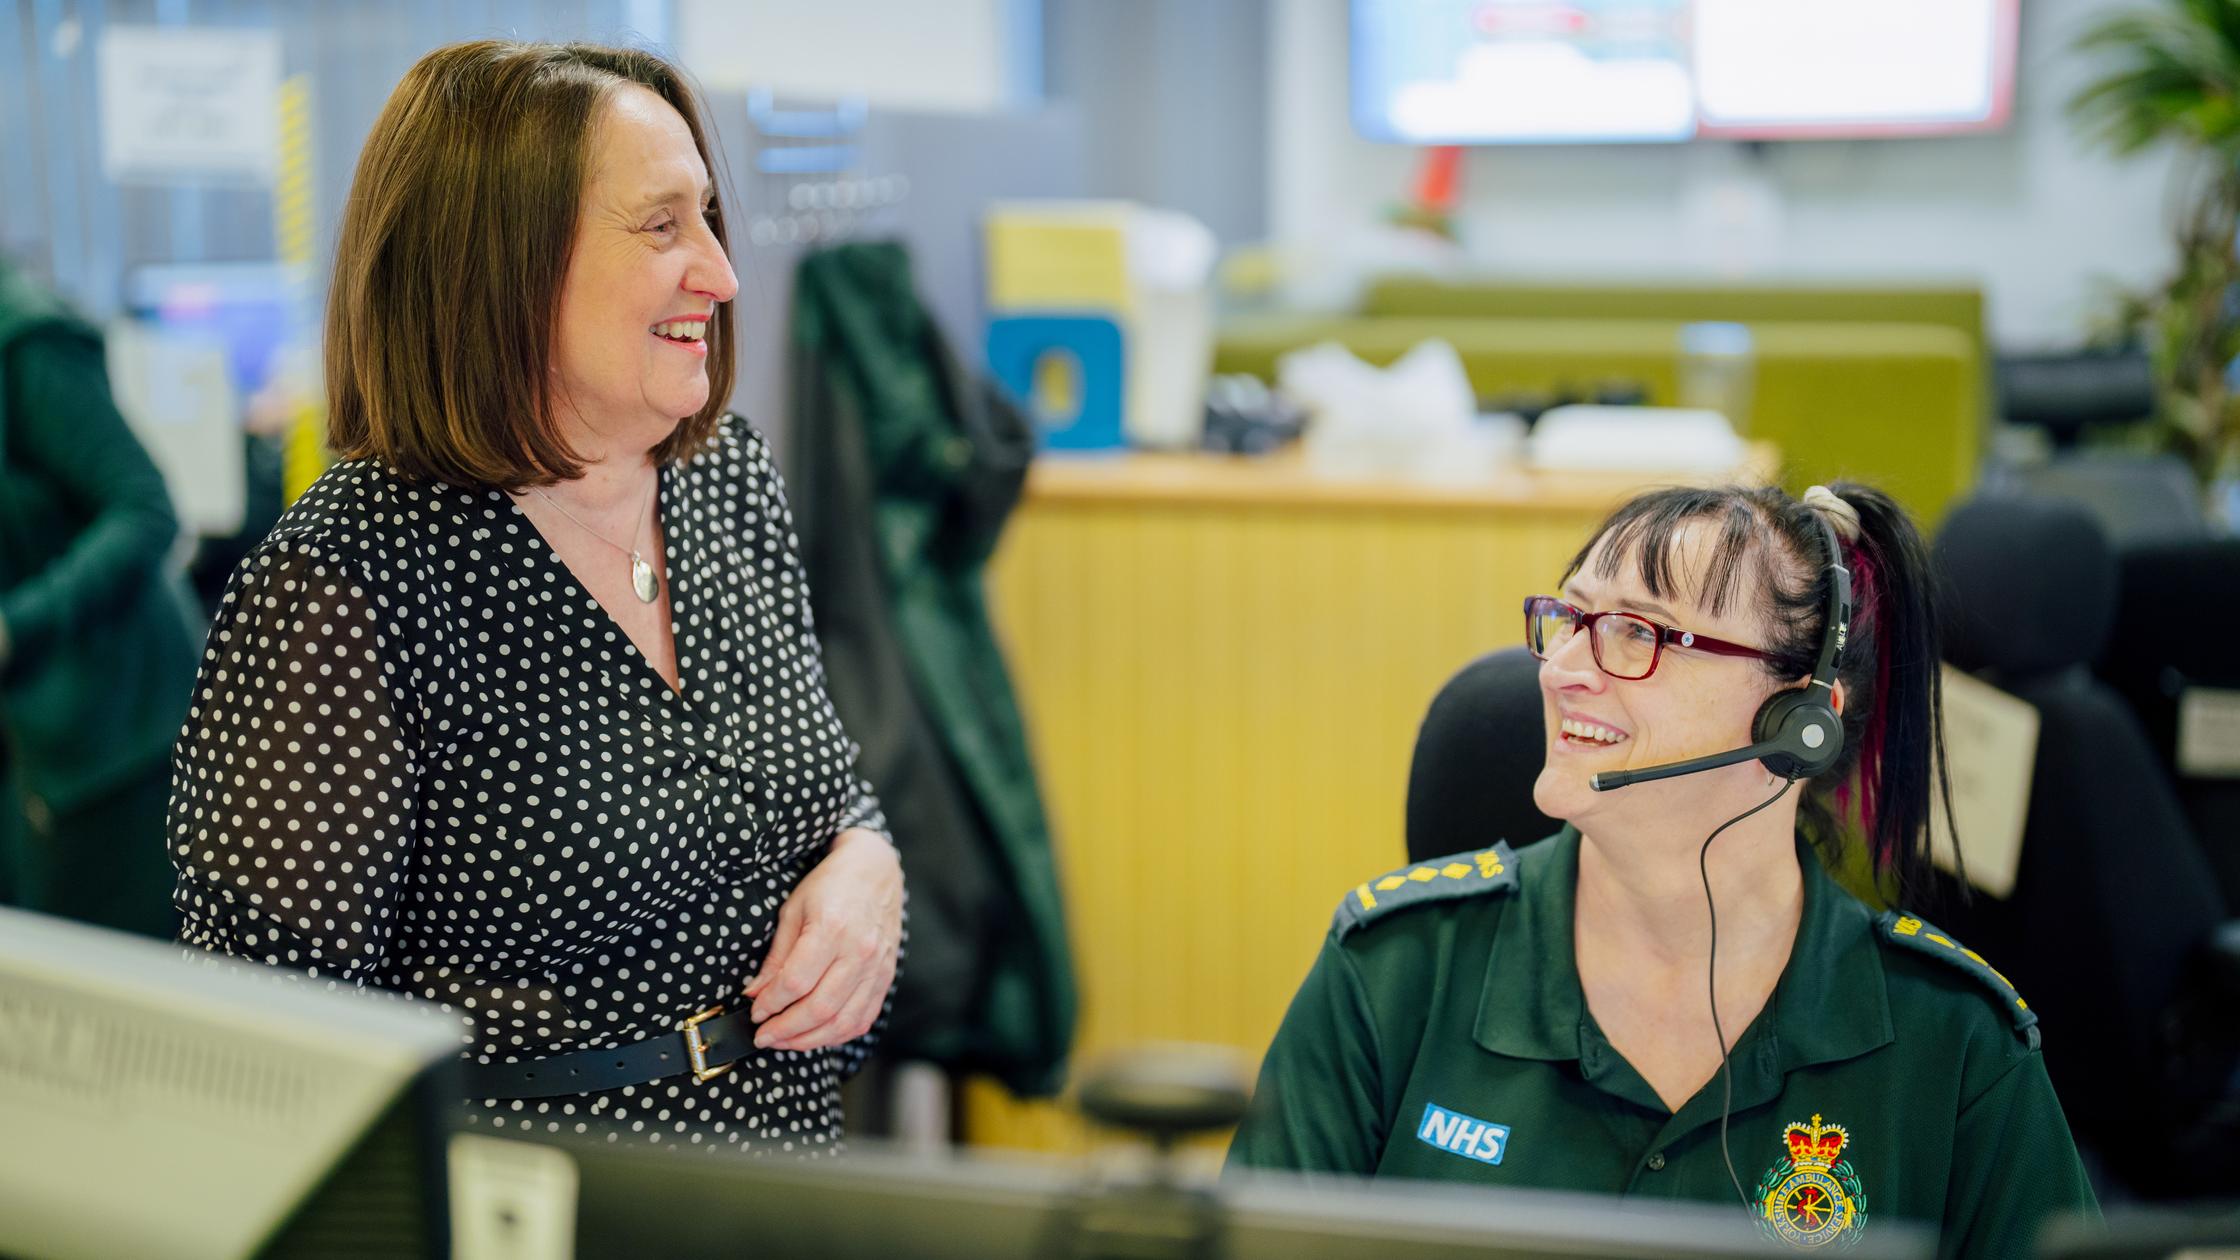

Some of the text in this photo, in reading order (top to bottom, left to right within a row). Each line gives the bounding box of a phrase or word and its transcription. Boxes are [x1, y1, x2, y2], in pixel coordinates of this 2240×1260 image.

[1422, 1110, 1505, 1160] NHS
[1775, 1173, 1843, 1244] YORKSHIRE AMBULANCE SERVICE
